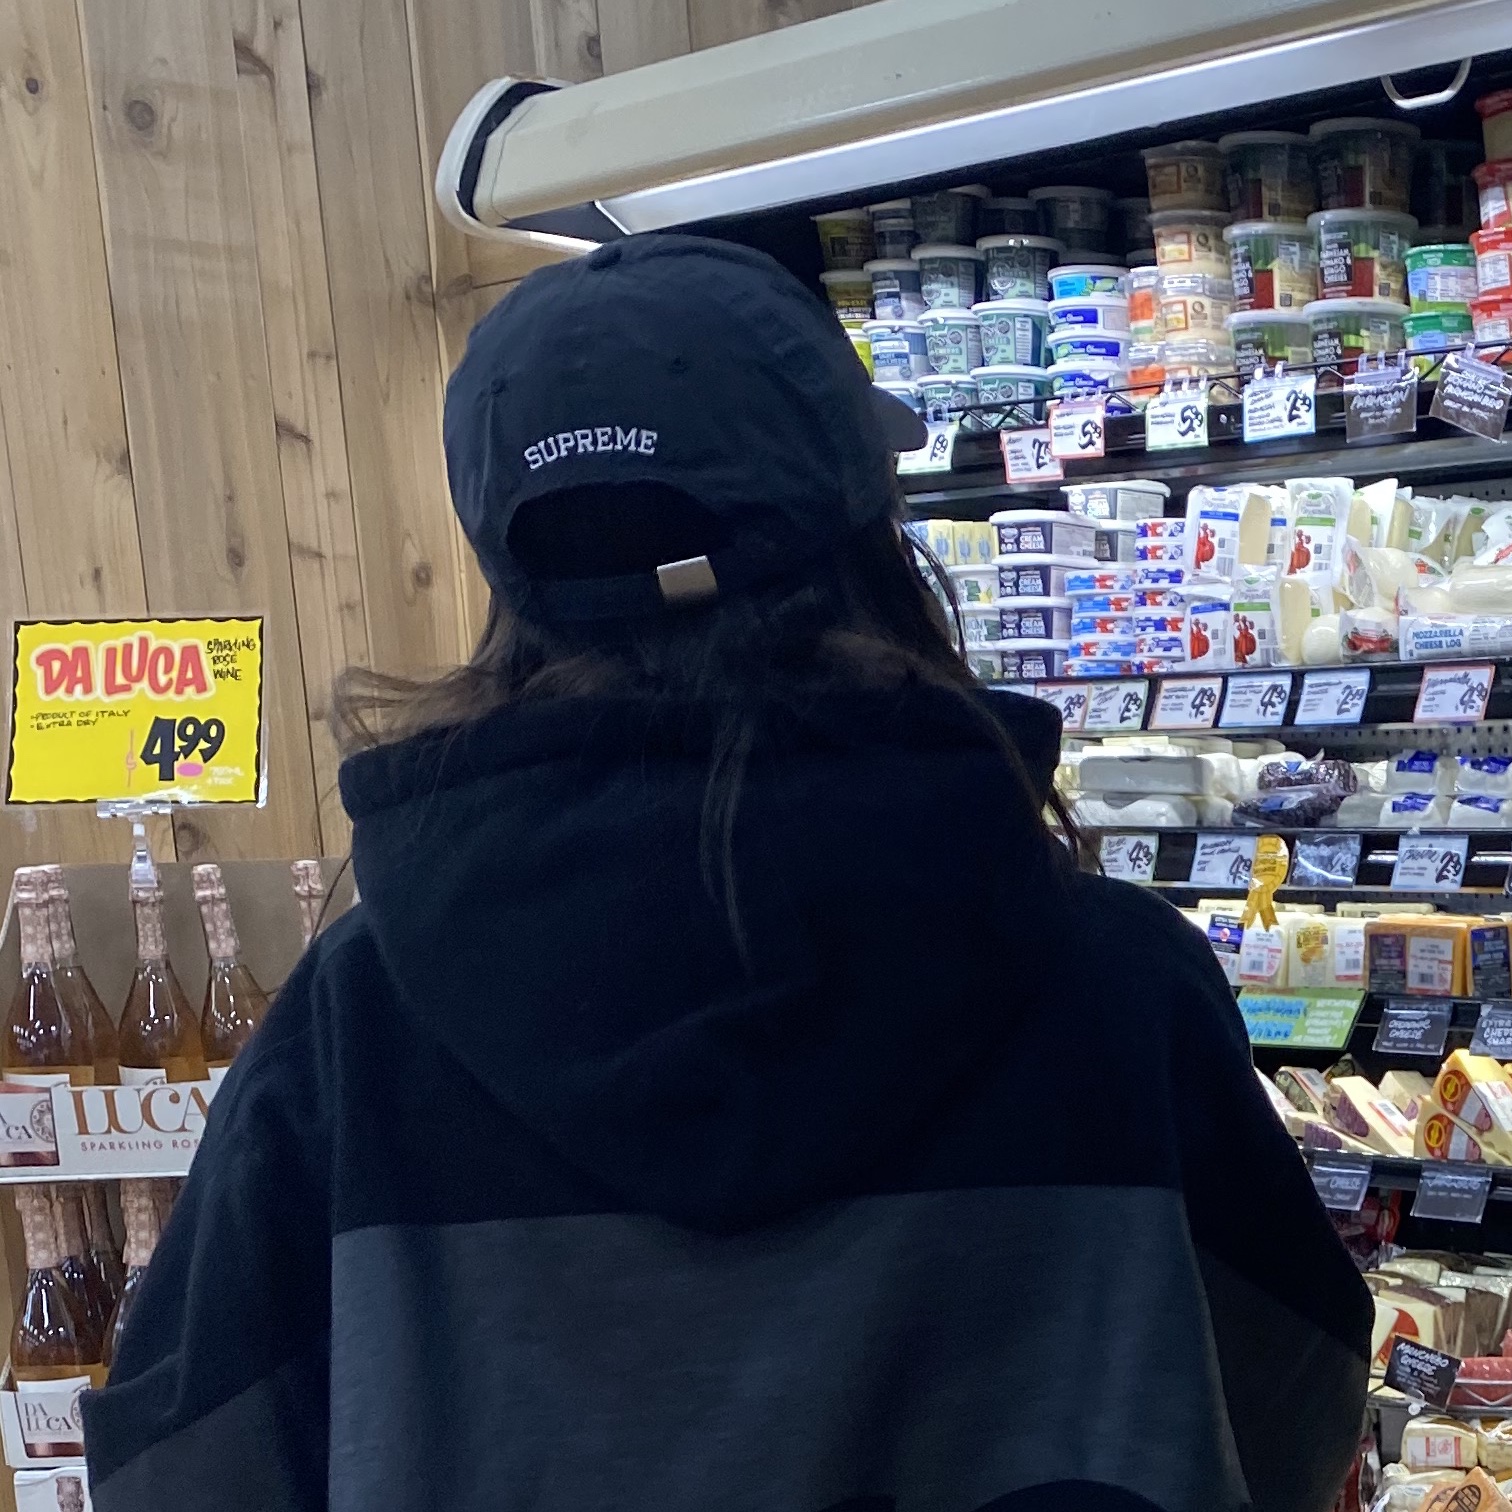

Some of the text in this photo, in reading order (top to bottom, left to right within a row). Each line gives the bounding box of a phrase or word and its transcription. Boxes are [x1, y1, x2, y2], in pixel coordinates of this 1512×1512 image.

[524, 425, 658, 471] SUPREME
[1412, 628, 1464, 640] MOZZARELLA
[1414, 638, 1462, 648] CHEESE LOG
[36, 636, 208, 696] DA LUCA
[95, 708, 130, 718] ITALY
[69, 1087, 211, 1136] LUCA
[81, 1138, 201, 1152] SPARKLING ROS
